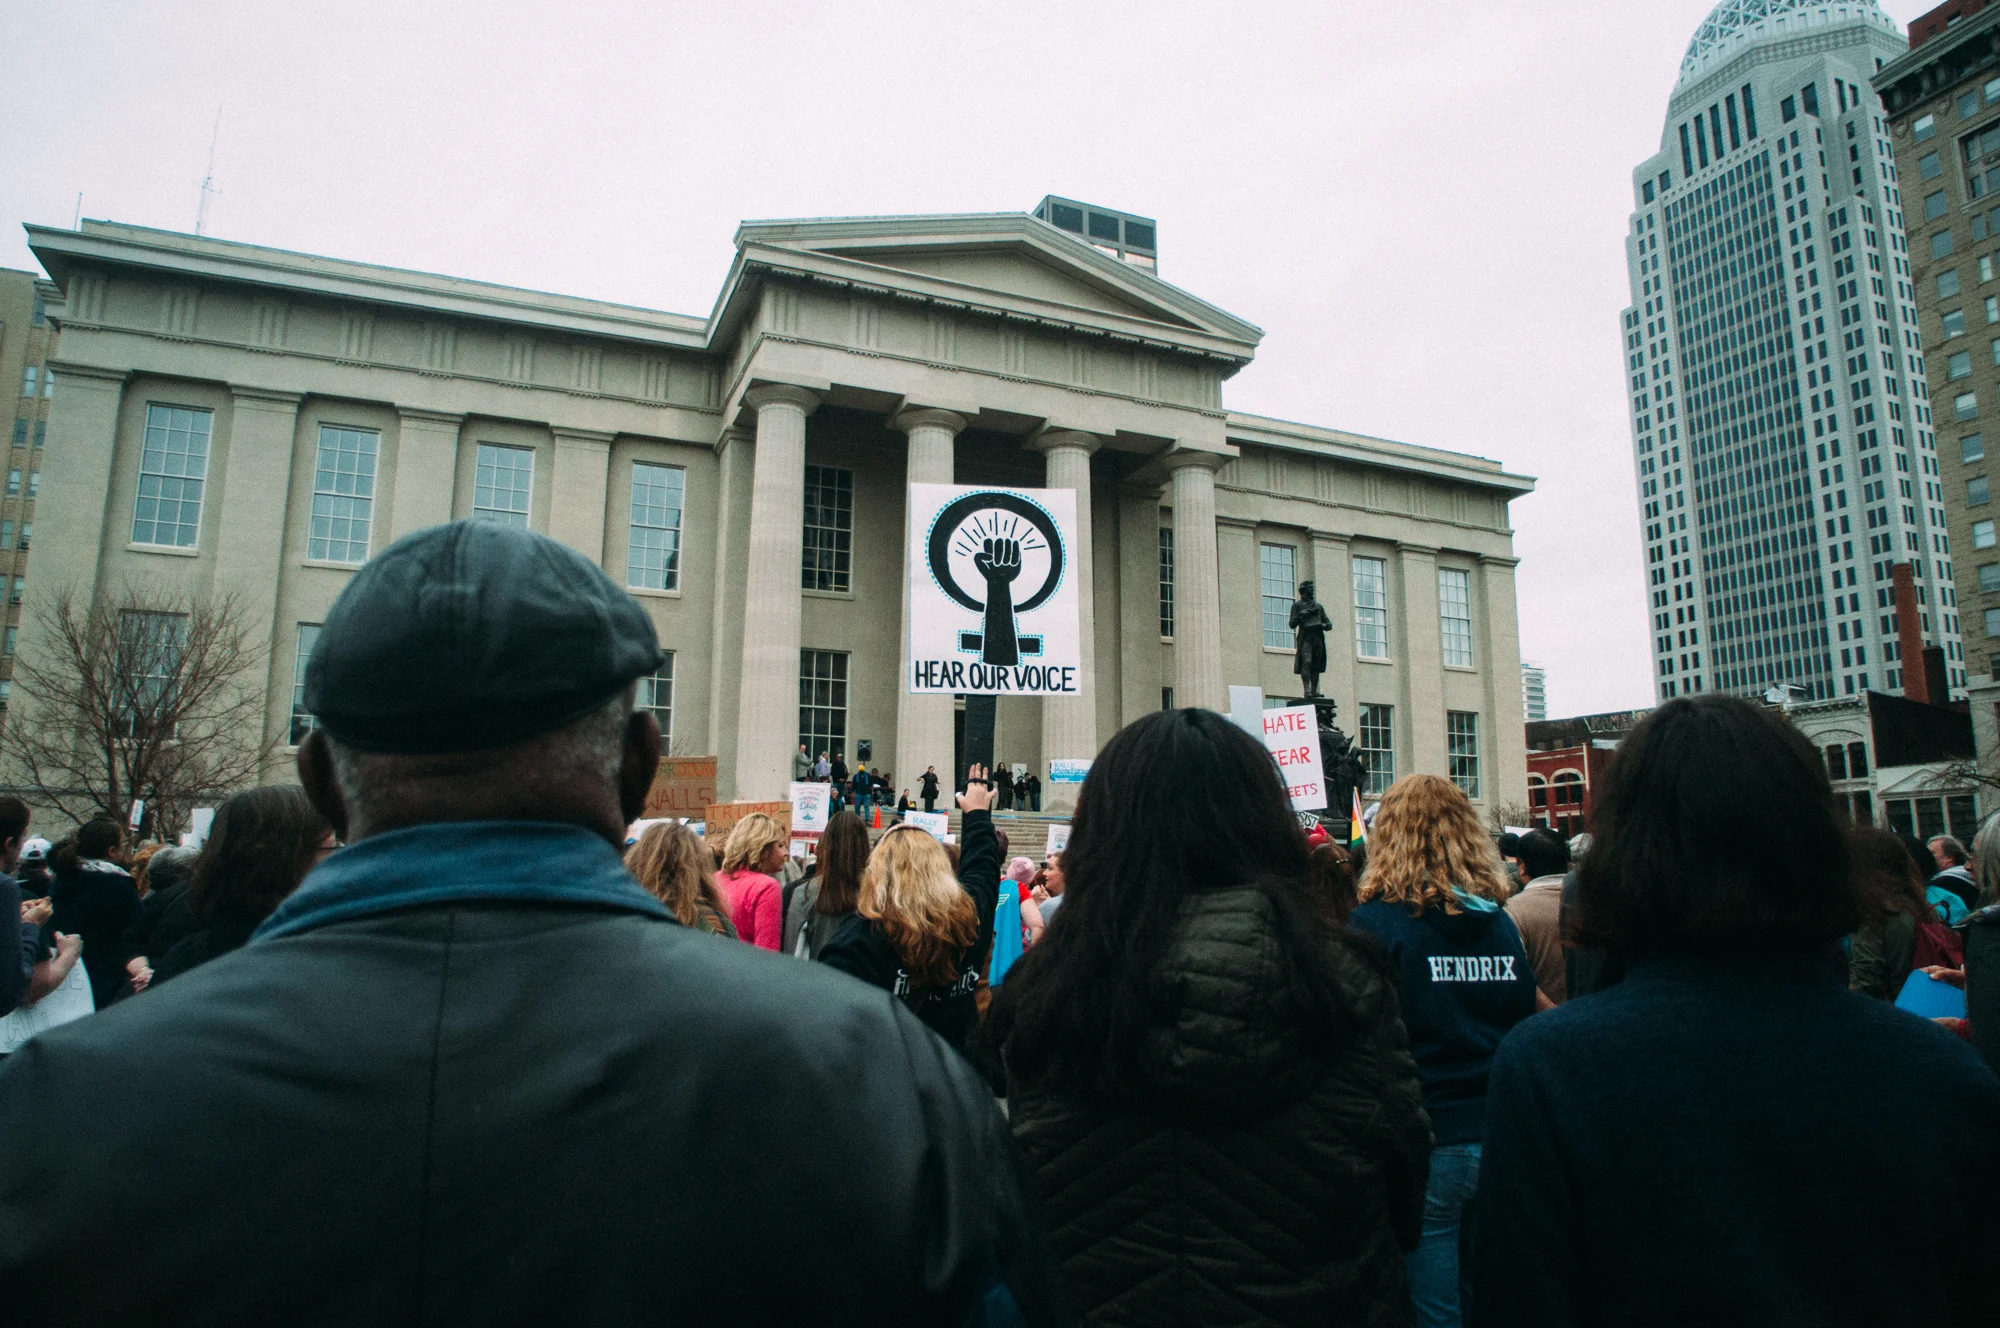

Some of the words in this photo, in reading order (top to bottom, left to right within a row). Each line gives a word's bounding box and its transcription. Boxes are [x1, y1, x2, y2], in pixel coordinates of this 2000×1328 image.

[916, 661, 967, 688] HEAR
[970, 663, 1010, 690] OUR
[1014, 665, 1076, 692] VOICE
[1263, 713, 1306, 735] HATE
[1289, 783, 1318, 798] EETS
[912, 816, 938, 826] RALLY
[1298, 811, 1318, 828] SIST
[1427, 955, 1517, 981] HENDRIX
